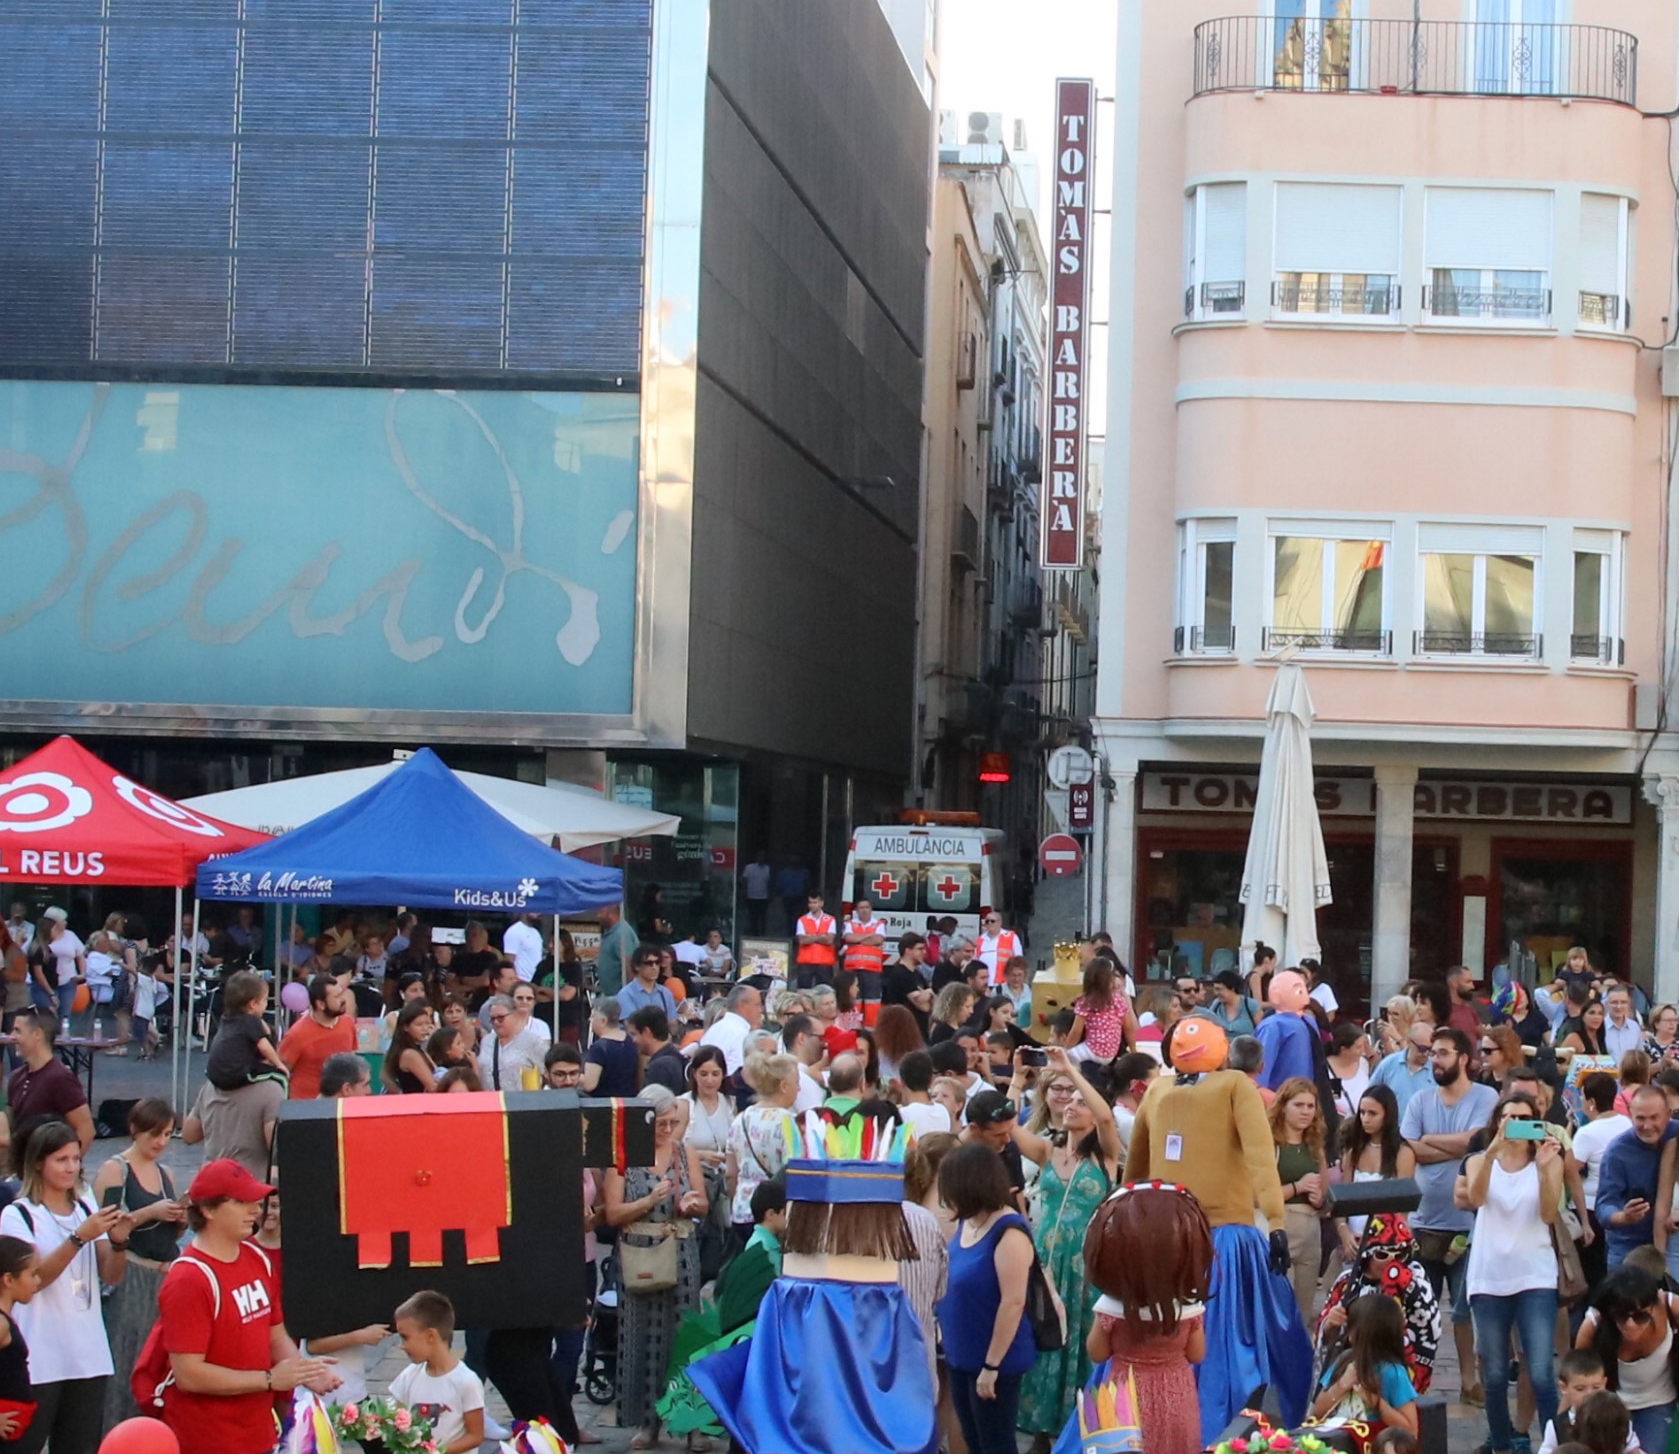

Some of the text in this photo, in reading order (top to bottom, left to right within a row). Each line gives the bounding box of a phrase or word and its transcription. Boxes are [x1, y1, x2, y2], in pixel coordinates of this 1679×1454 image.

[874, 836, 965, 856] AMBULÀNCIA
[21, 849, 105, 876] REUS
[257, 871, 333, 892] la Martina
[453, 888, 527, 908] Kids&Us
[890, 916, 912, 929] Roja
[231, 1278, 270, 1318] HH
